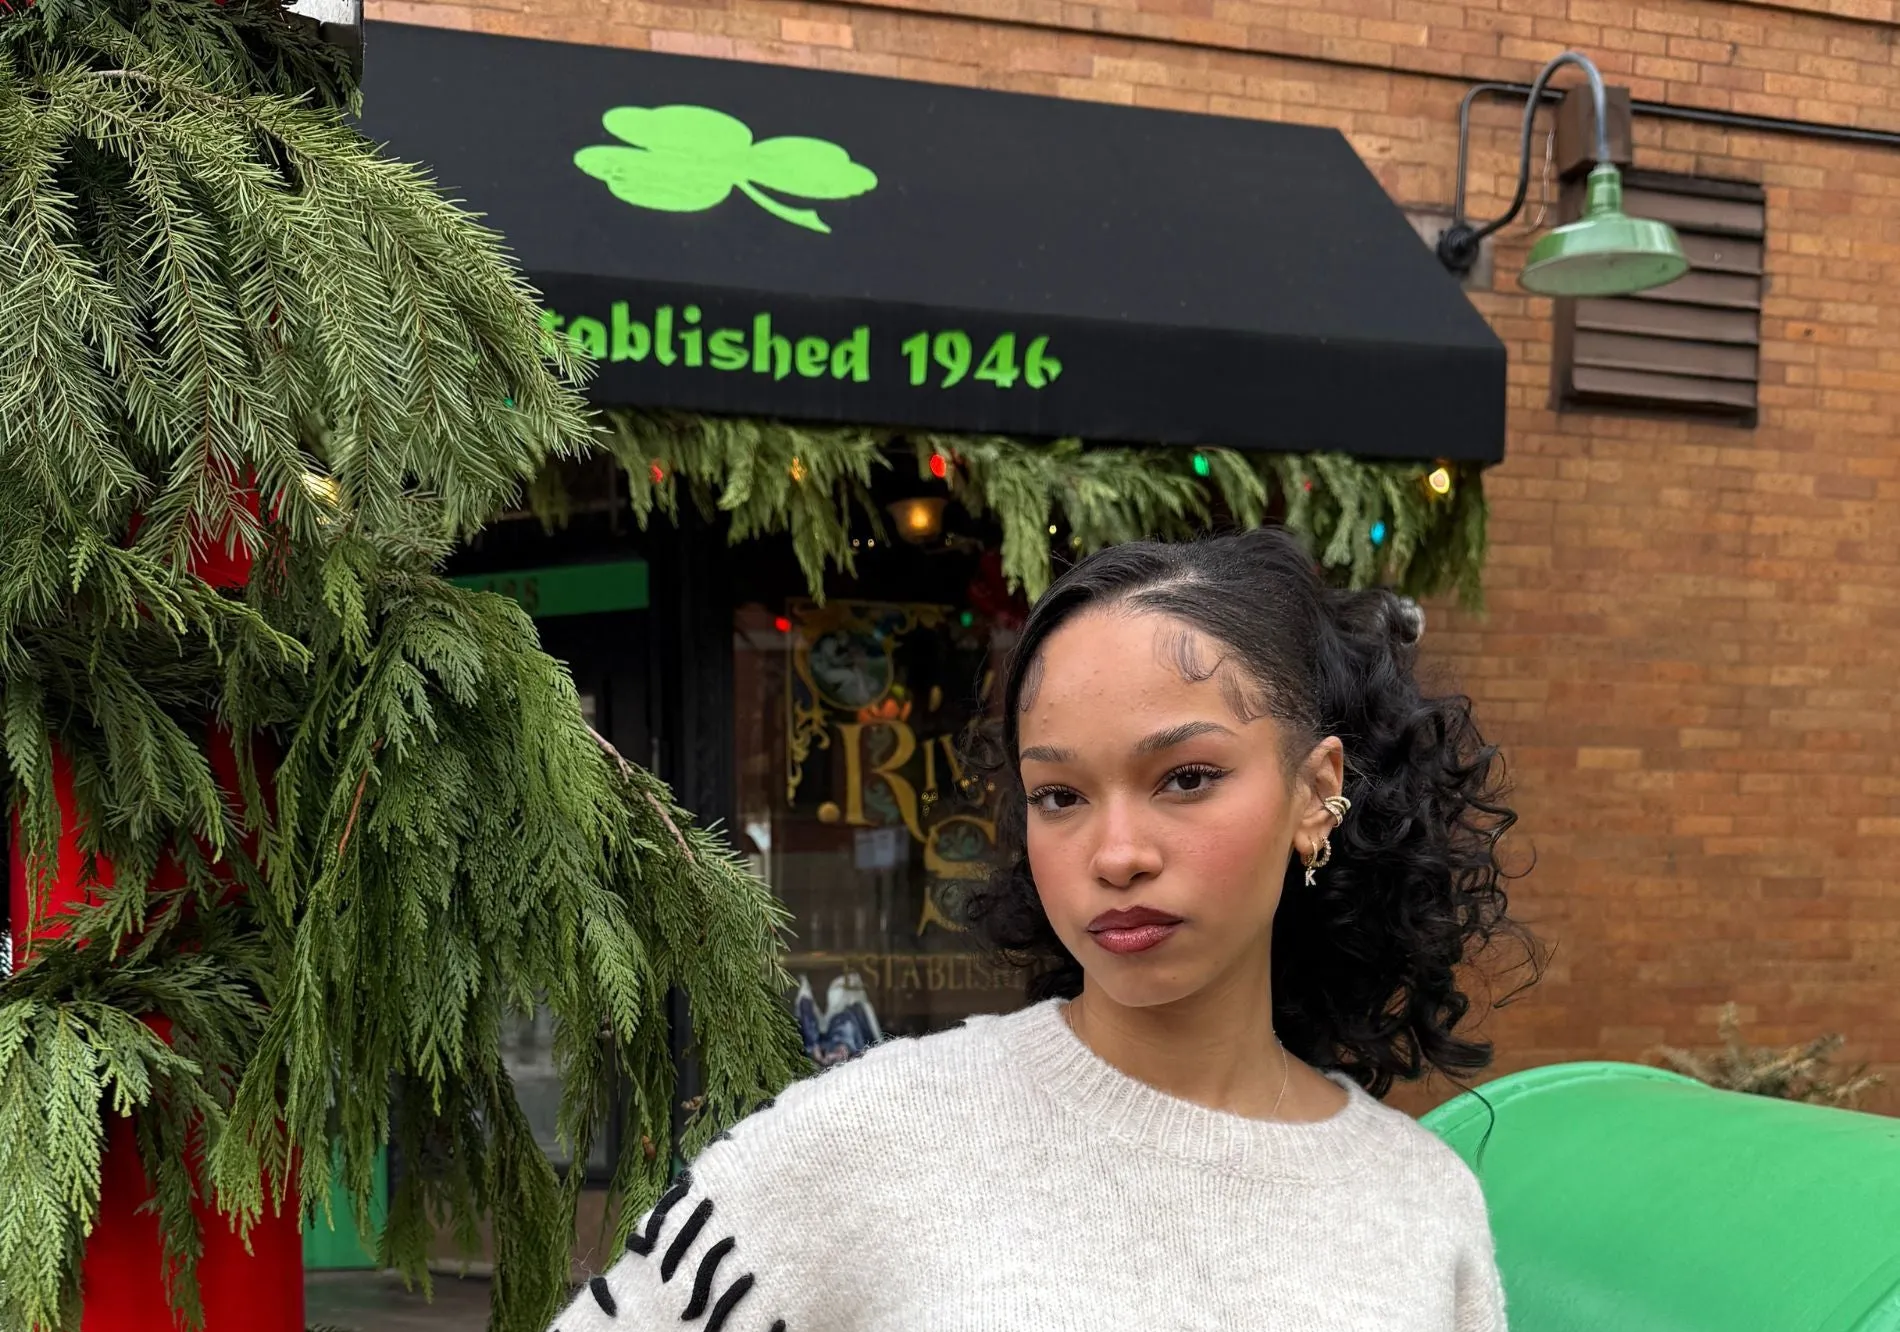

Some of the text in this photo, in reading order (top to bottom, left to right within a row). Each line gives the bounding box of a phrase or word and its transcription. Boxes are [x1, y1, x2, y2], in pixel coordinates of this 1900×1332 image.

[540, 300, 1063, 389] tablished 1946
[1305, 869, 1317, 887] K
